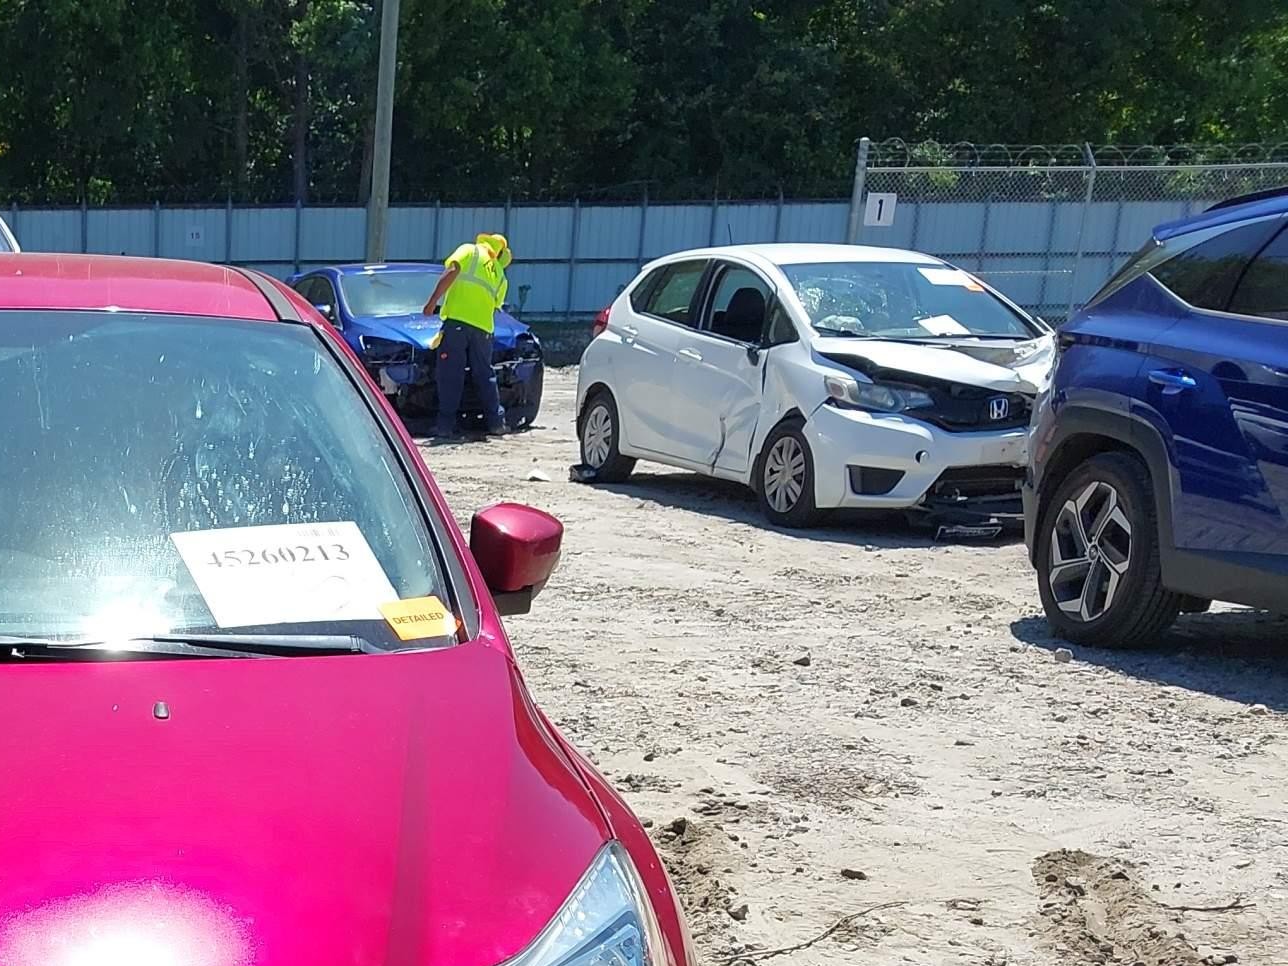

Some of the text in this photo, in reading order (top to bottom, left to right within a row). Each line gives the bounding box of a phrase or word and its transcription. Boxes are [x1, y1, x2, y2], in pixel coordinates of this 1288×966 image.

[877, 199, 884, 221] 1
[207, 543, 350, 568] 45260213
[392, 612, 444, 625] DETAILED
